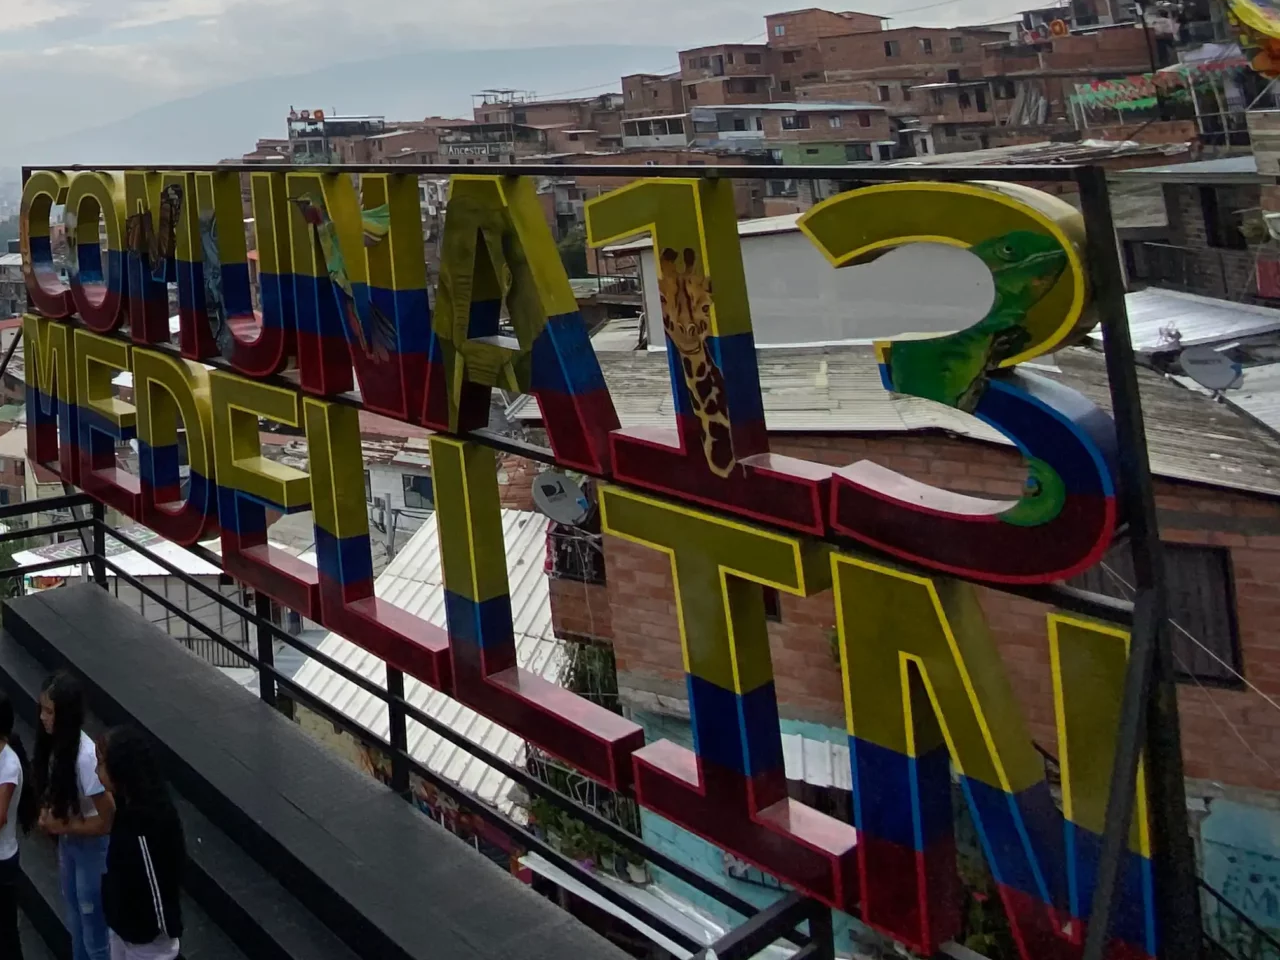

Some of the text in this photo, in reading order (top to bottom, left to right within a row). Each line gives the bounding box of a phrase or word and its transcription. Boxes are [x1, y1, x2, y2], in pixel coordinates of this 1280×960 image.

[448, 144, 489, 156] Ancestral
[20, 170, 1117, 584] COMUNA 13
[22, 314, 1160, 960] MEDELLIN
